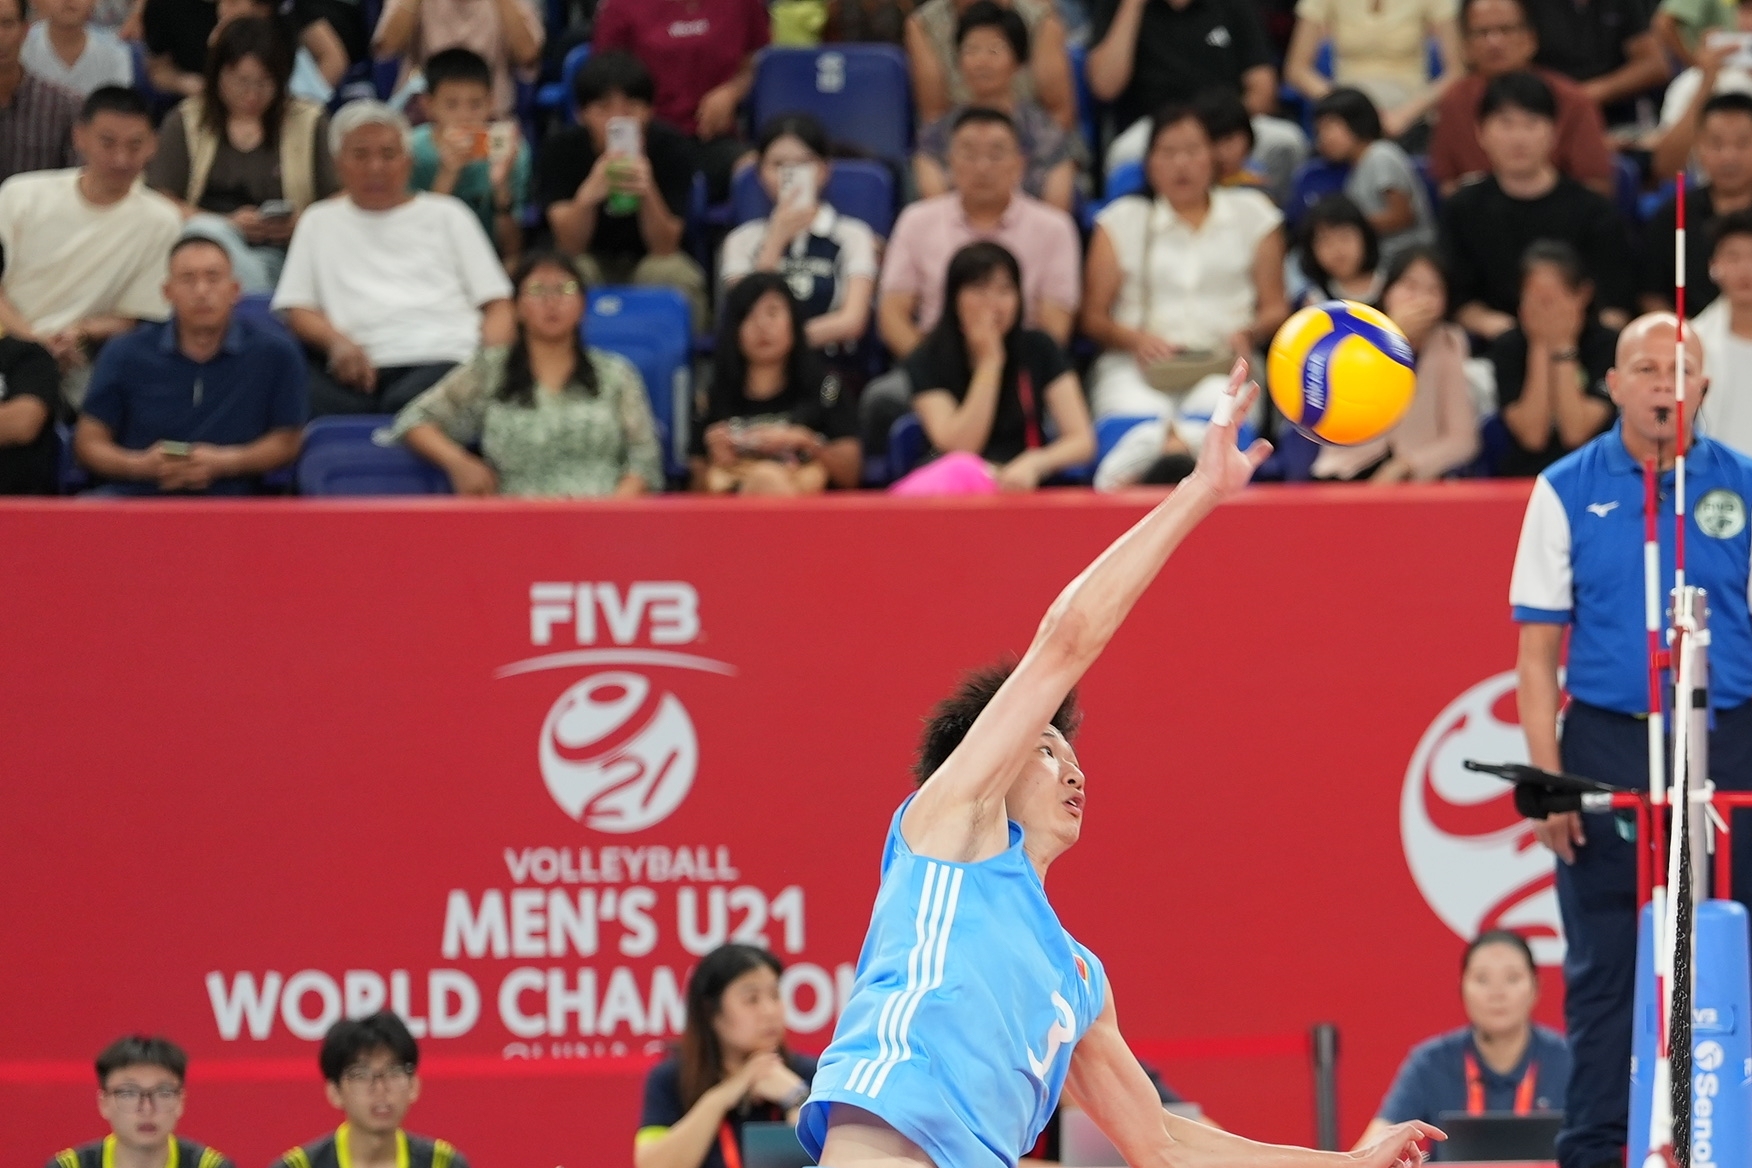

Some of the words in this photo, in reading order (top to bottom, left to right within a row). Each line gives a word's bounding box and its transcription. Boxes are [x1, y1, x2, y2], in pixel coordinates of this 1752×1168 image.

[530, 581, 699, 646] FIVB
[504, 845, 738, 884] VOLLEYBALL
[677, 884, 806, 955] U21
[205, 968, 481, 1041] WORLD
